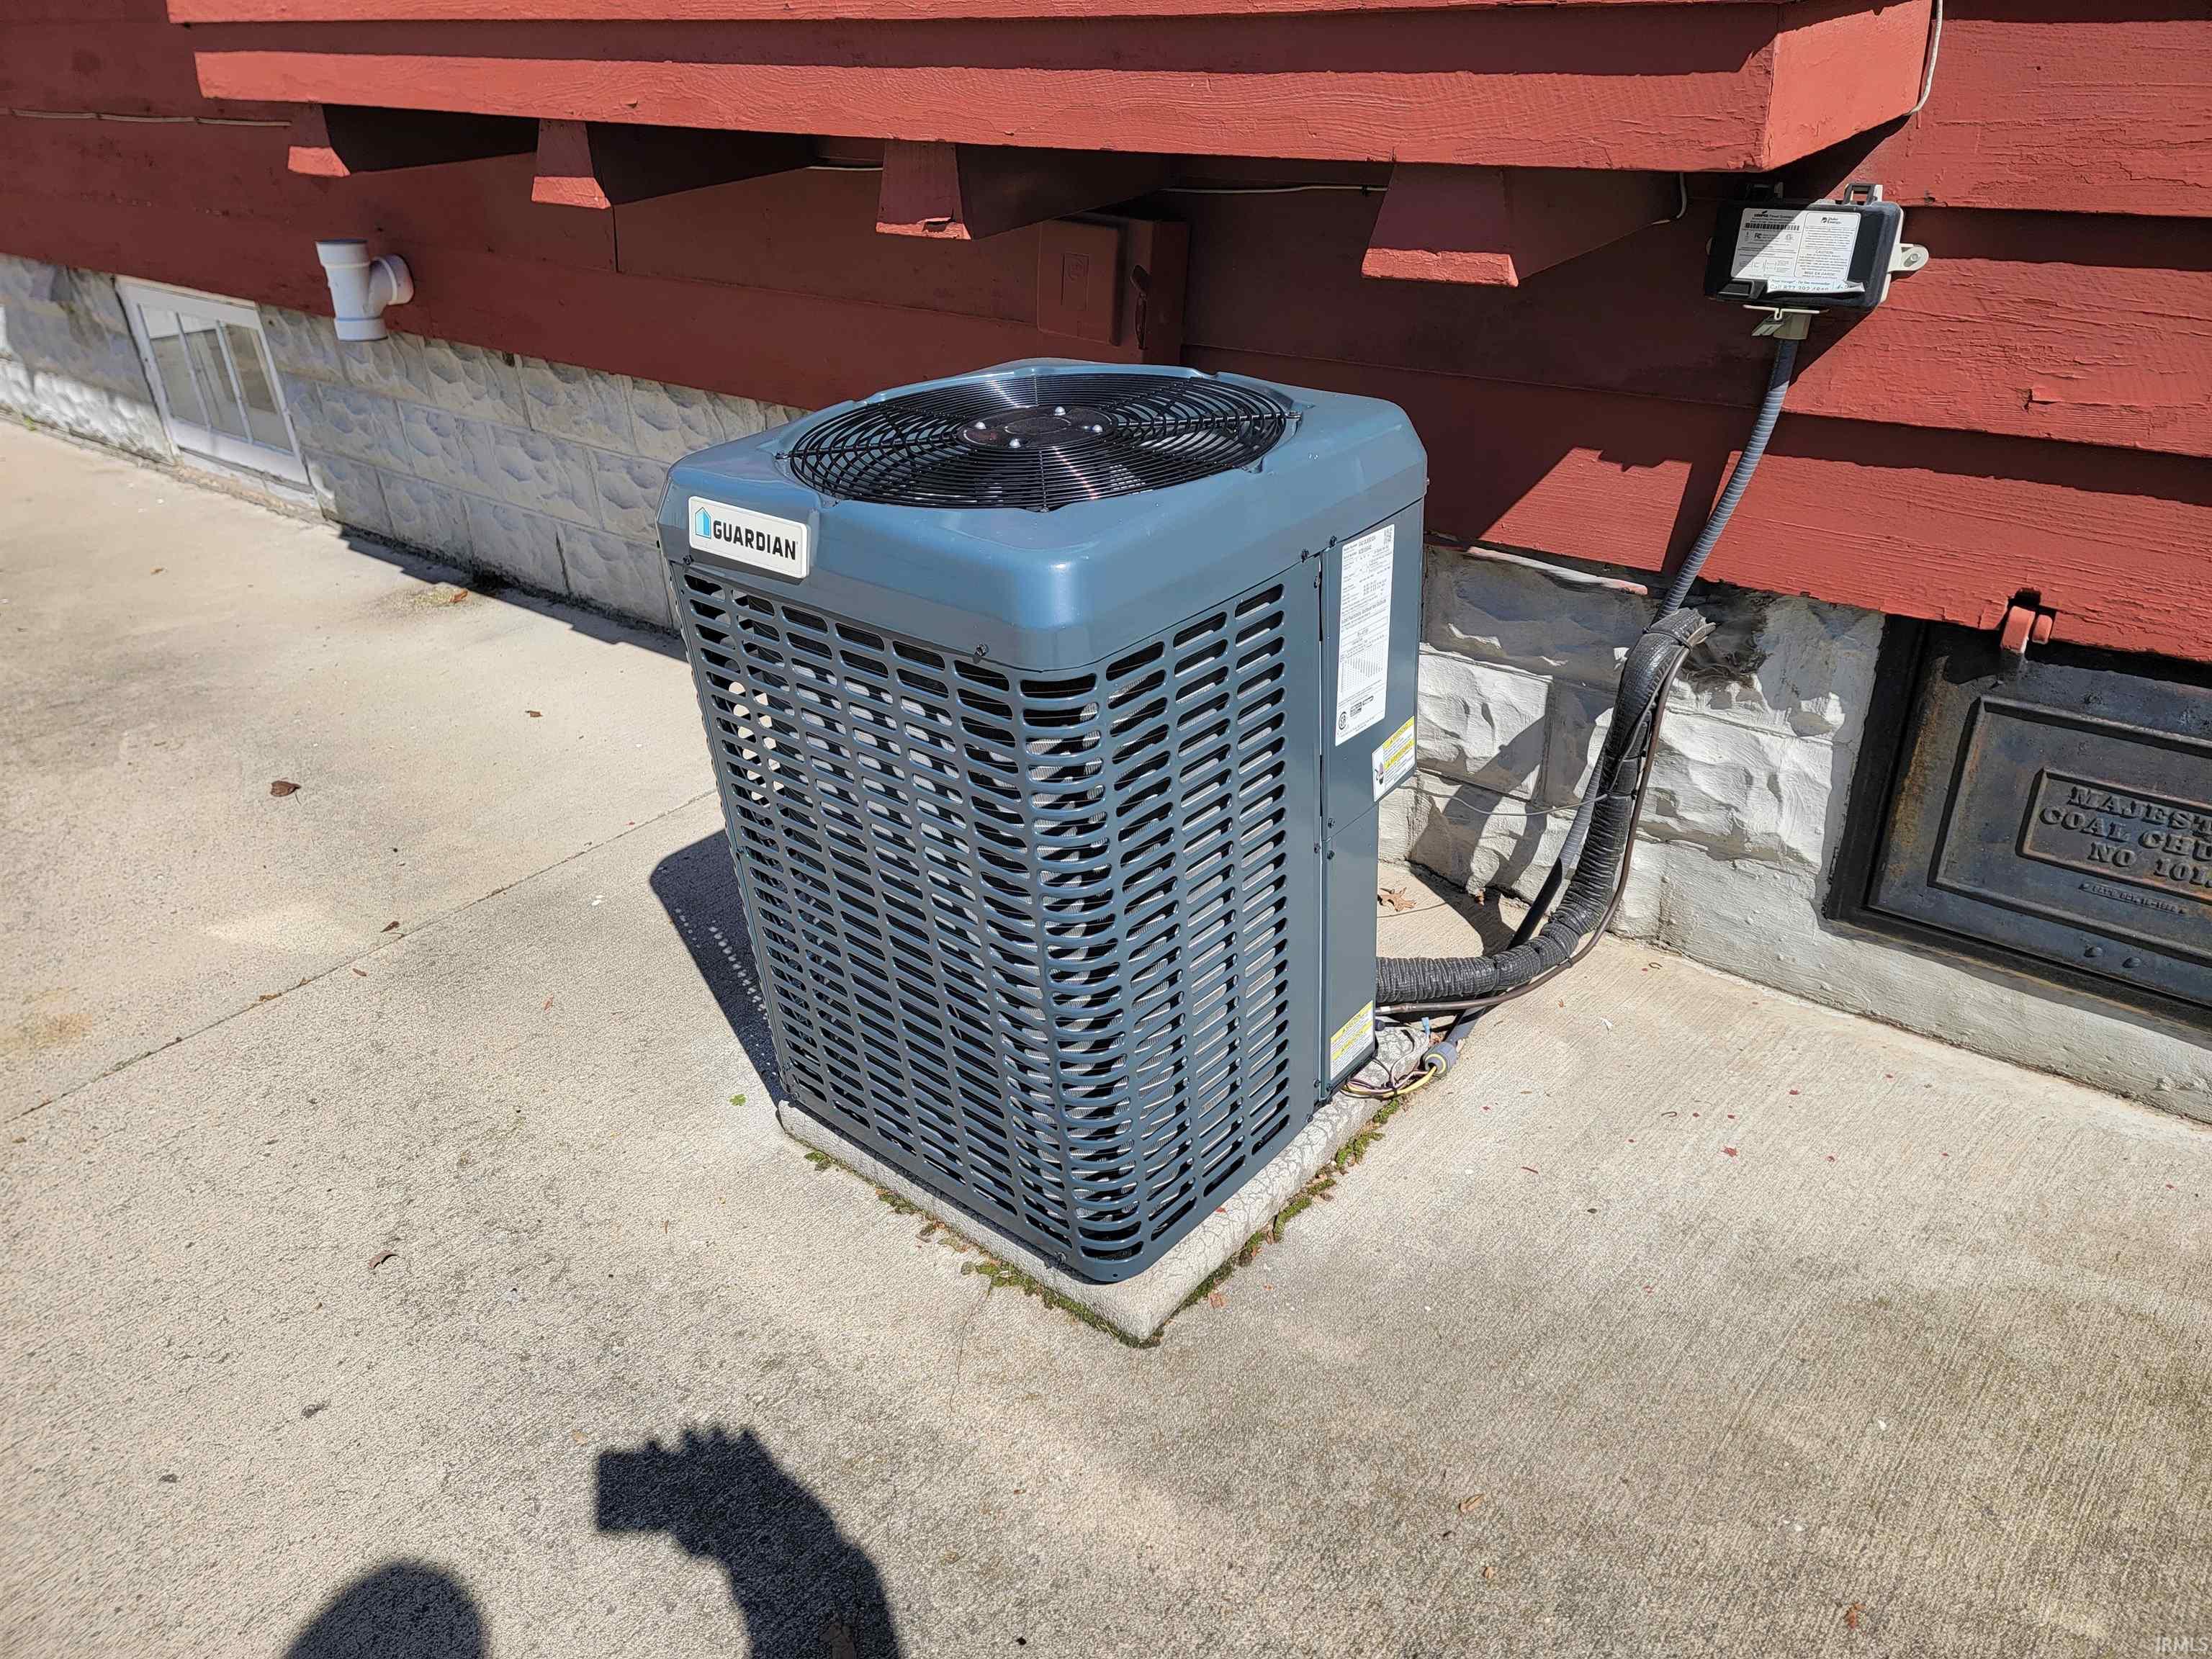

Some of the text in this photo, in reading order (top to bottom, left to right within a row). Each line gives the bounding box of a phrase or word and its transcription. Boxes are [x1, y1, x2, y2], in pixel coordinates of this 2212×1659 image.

[713, 520, 796, 560] GUARDIAN
[2039, 805, 2131, 842] COAL
[2087, 841, 2212, 888] NO 101
